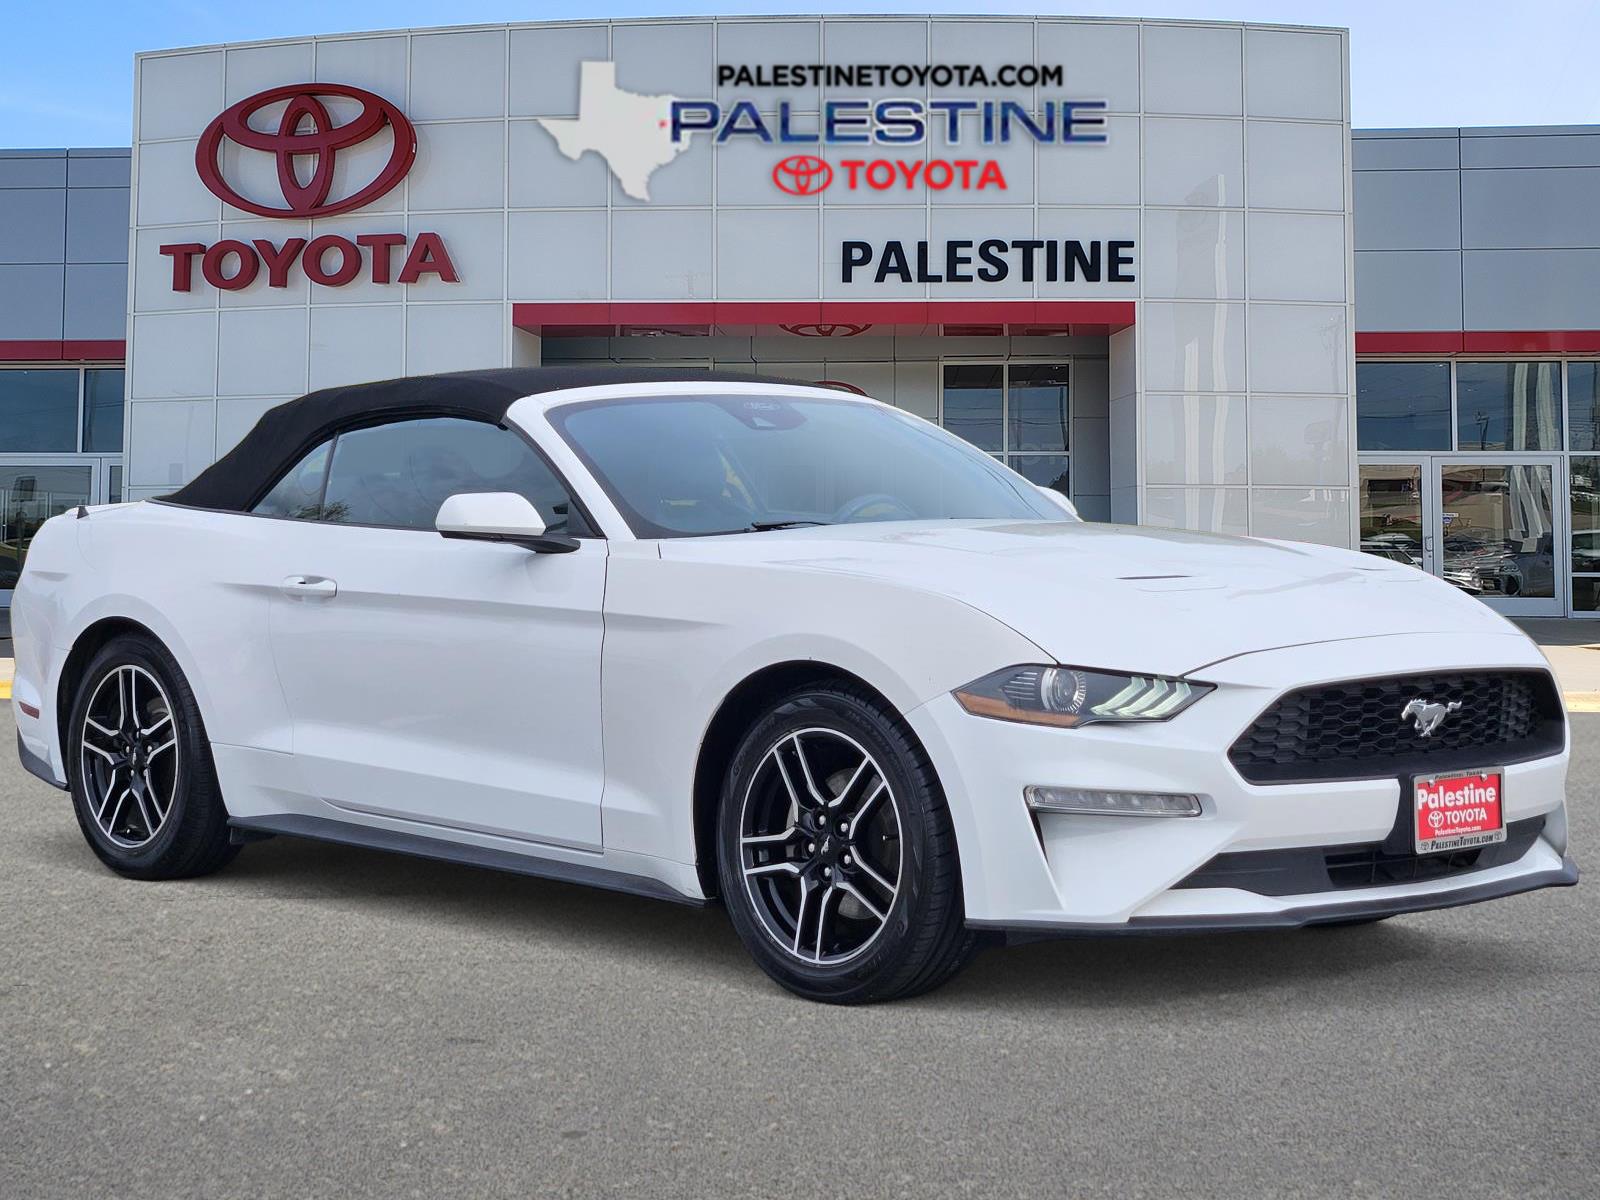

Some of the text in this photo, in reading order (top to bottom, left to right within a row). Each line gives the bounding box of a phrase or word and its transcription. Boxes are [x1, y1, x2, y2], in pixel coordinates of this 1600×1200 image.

[160, 232, 461, 292] TOYOTA
[842, 240, 1135, 283] PALESTINE
[1417, 784, 1496, 809] Palestine
[1445, 808, 1487, 824] TOYOTA
